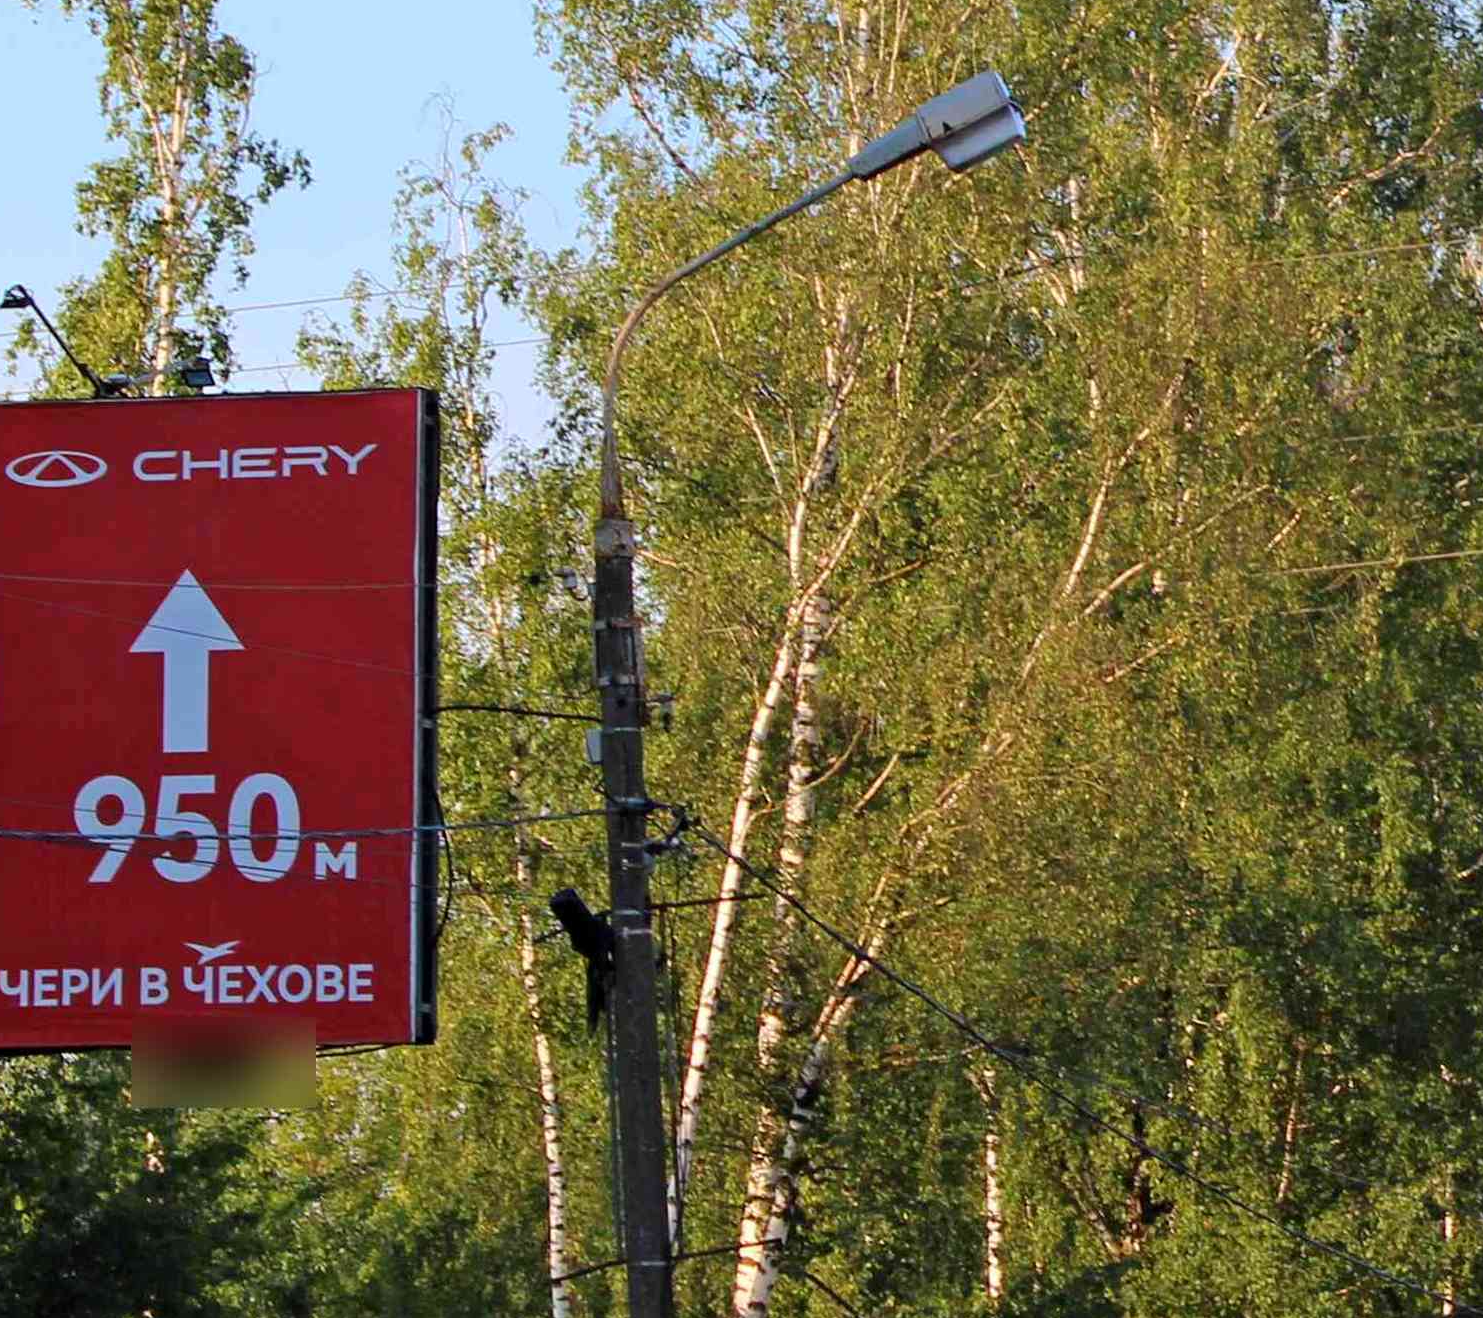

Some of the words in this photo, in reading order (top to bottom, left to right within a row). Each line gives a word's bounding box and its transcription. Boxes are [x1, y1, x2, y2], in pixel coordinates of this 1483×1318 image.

[132, 443, 379, 482] CHERY
[73, 772, 301, 883] 950
[139, 967, 170, 1006] В
[182, 962, 375, 1005] ЧЕХОВЕ
